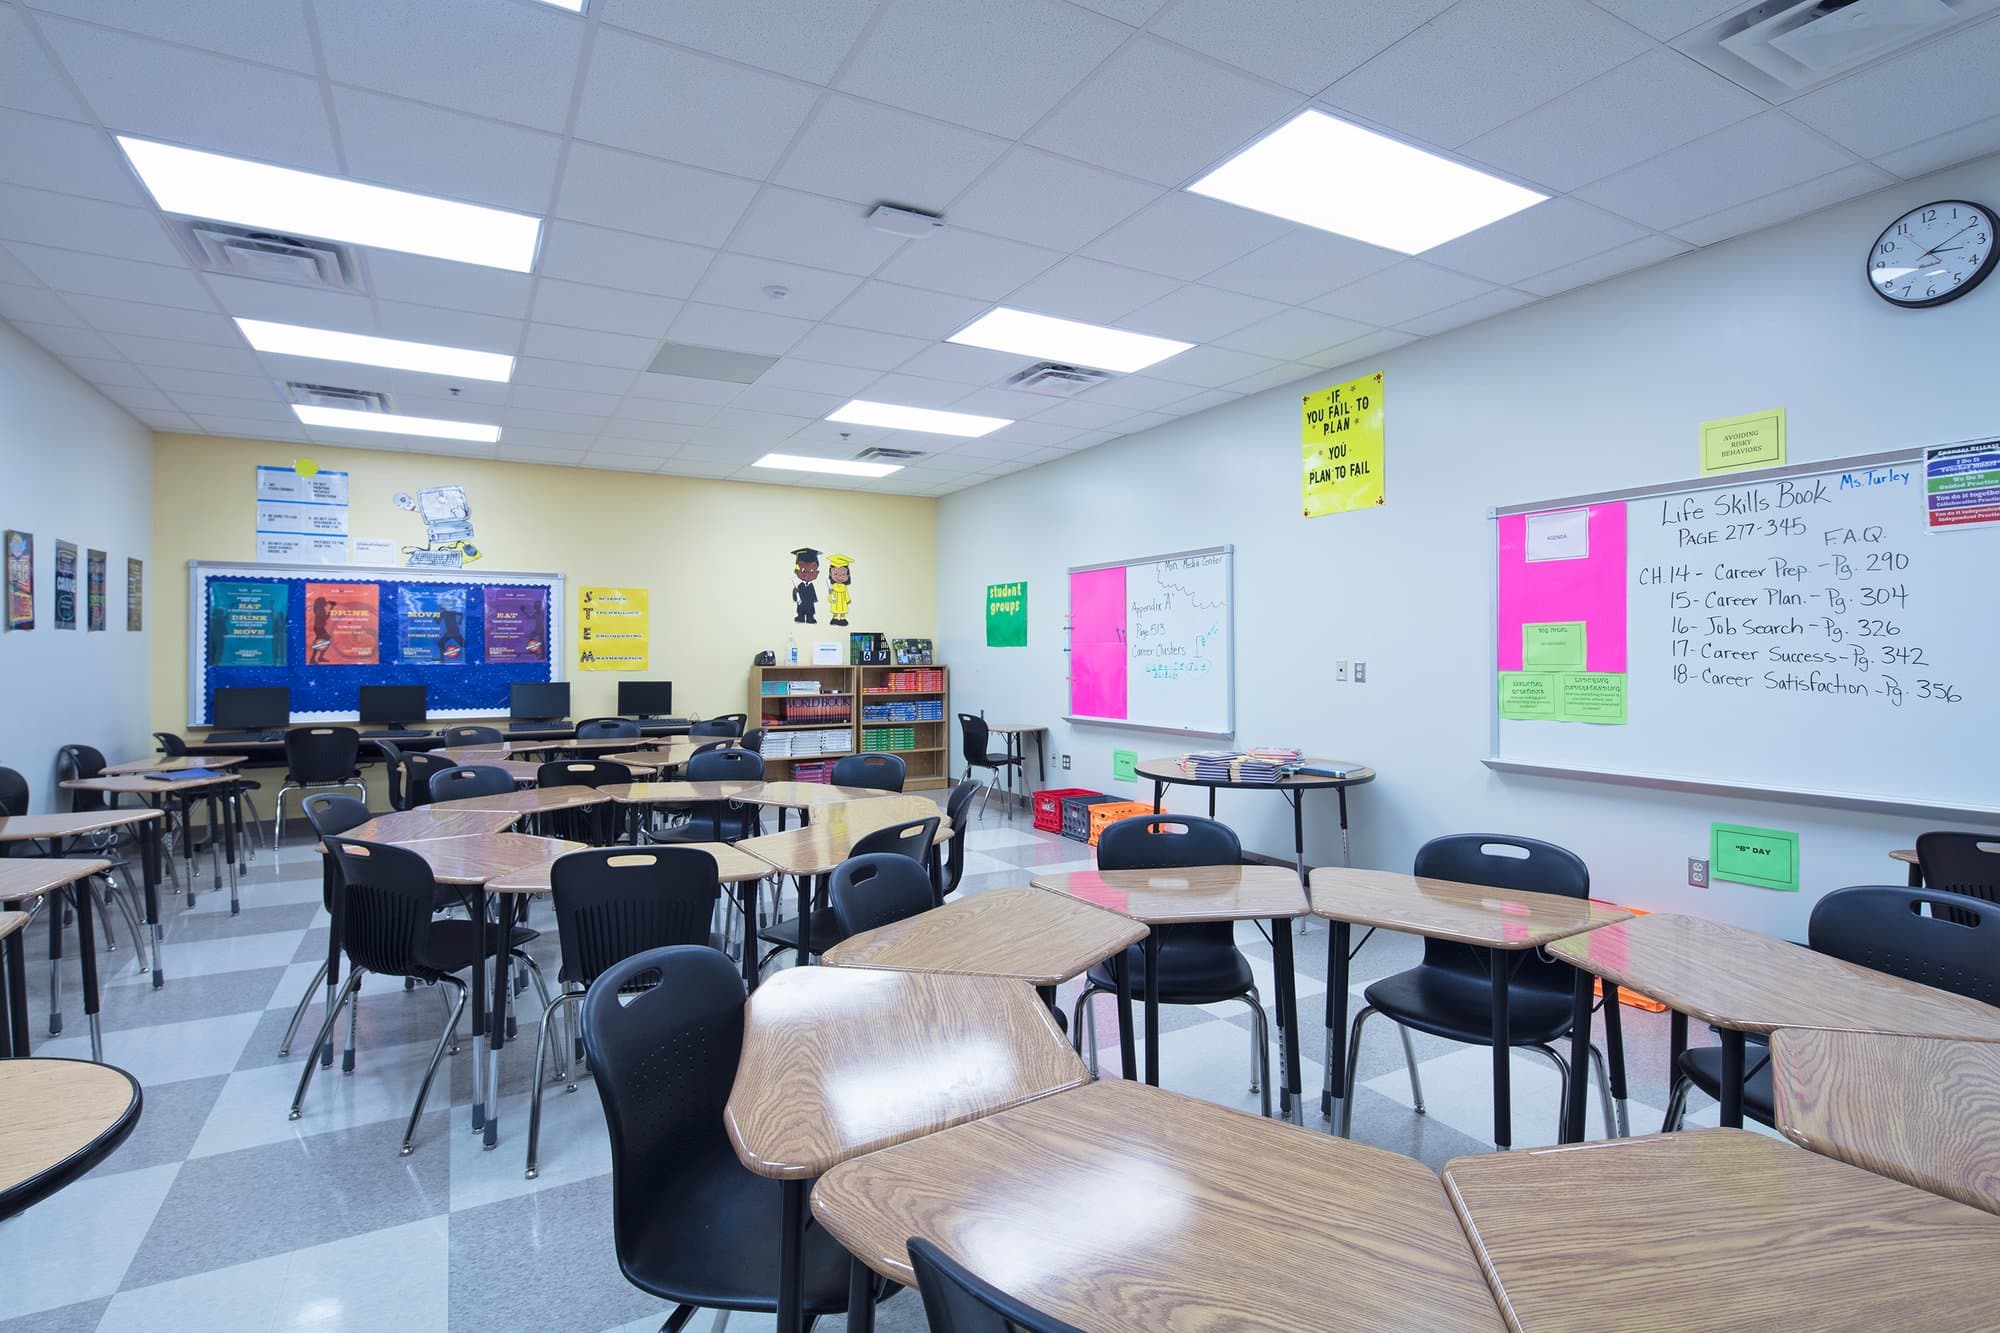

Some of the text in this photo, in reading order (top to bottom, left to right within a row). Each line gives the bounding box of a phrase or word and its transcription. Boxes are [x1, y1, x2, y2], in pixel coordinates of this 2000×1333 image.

[1921, 209, 1936, 223] 12
[1952, 208, 1957, 220] 1
[1969, 216, 1979, 228] 2
[1898, 224, 1908, 236] 11
[1977, 232, 1986, 244] 3
[1880, 241, 1895, 255] 10
[1968, 254, 1980, 265] 4
[1952, 272, 1962, 285] 5
[1902, 286, 1912, 297] 7
[1926, 284, 1936, 297] 6
[1331, 389, 1340, 404] IF
[1306, 396, 1369, 424] YOU FAIL TO
[1324, 417, 1350, 436] PLAN
[1724, 430, 1759, 442] AVOIDING
[1731, 439, 1752, 448] RISKY
[1328, 444, 1346, 460] YOU
[1722, 446, 1762, 457] BEHAVIORS
[1309, 461, 1370, 485] PLAN TO FAIL
[1864, 468, 1910, 486] Turley
[1662, 480, 1832, 526] Life Skills Book
[1678, 517, 1806, 548] PAGE 277-345
[1202, 556, 1222, 567] Center
[1714, 564, 1766, 580] Career
[1866, 552, 1909, 572] 290
[990, 583, 1022, 598] student
[1704, 591, 1758, 608] Career
[1860, 584, 1909, 609] 304
[990, 600, 1020, 616] groups
[1132, 598, 1162, 619] Appendix
[1150, 623, 1166, 636] 513
[1704, 616, 1737, 636] Job
[1742, 617, 1804, 635] Search
[1858, 619, 1900, 636] 326
[864, 651, 871, 660] 6
[1132, 642, 1186, 658] Career Clusters
[1701, 643, 1760, 660] Career
[1881, 646, 1929, 666] 342
[1702, 667, 1752, 687] Career
[1764, 670, 1868, 696] Satisfaction
[1916, 679, 1962, 703] 356
[1752, 847, 1772, 856] DAY
